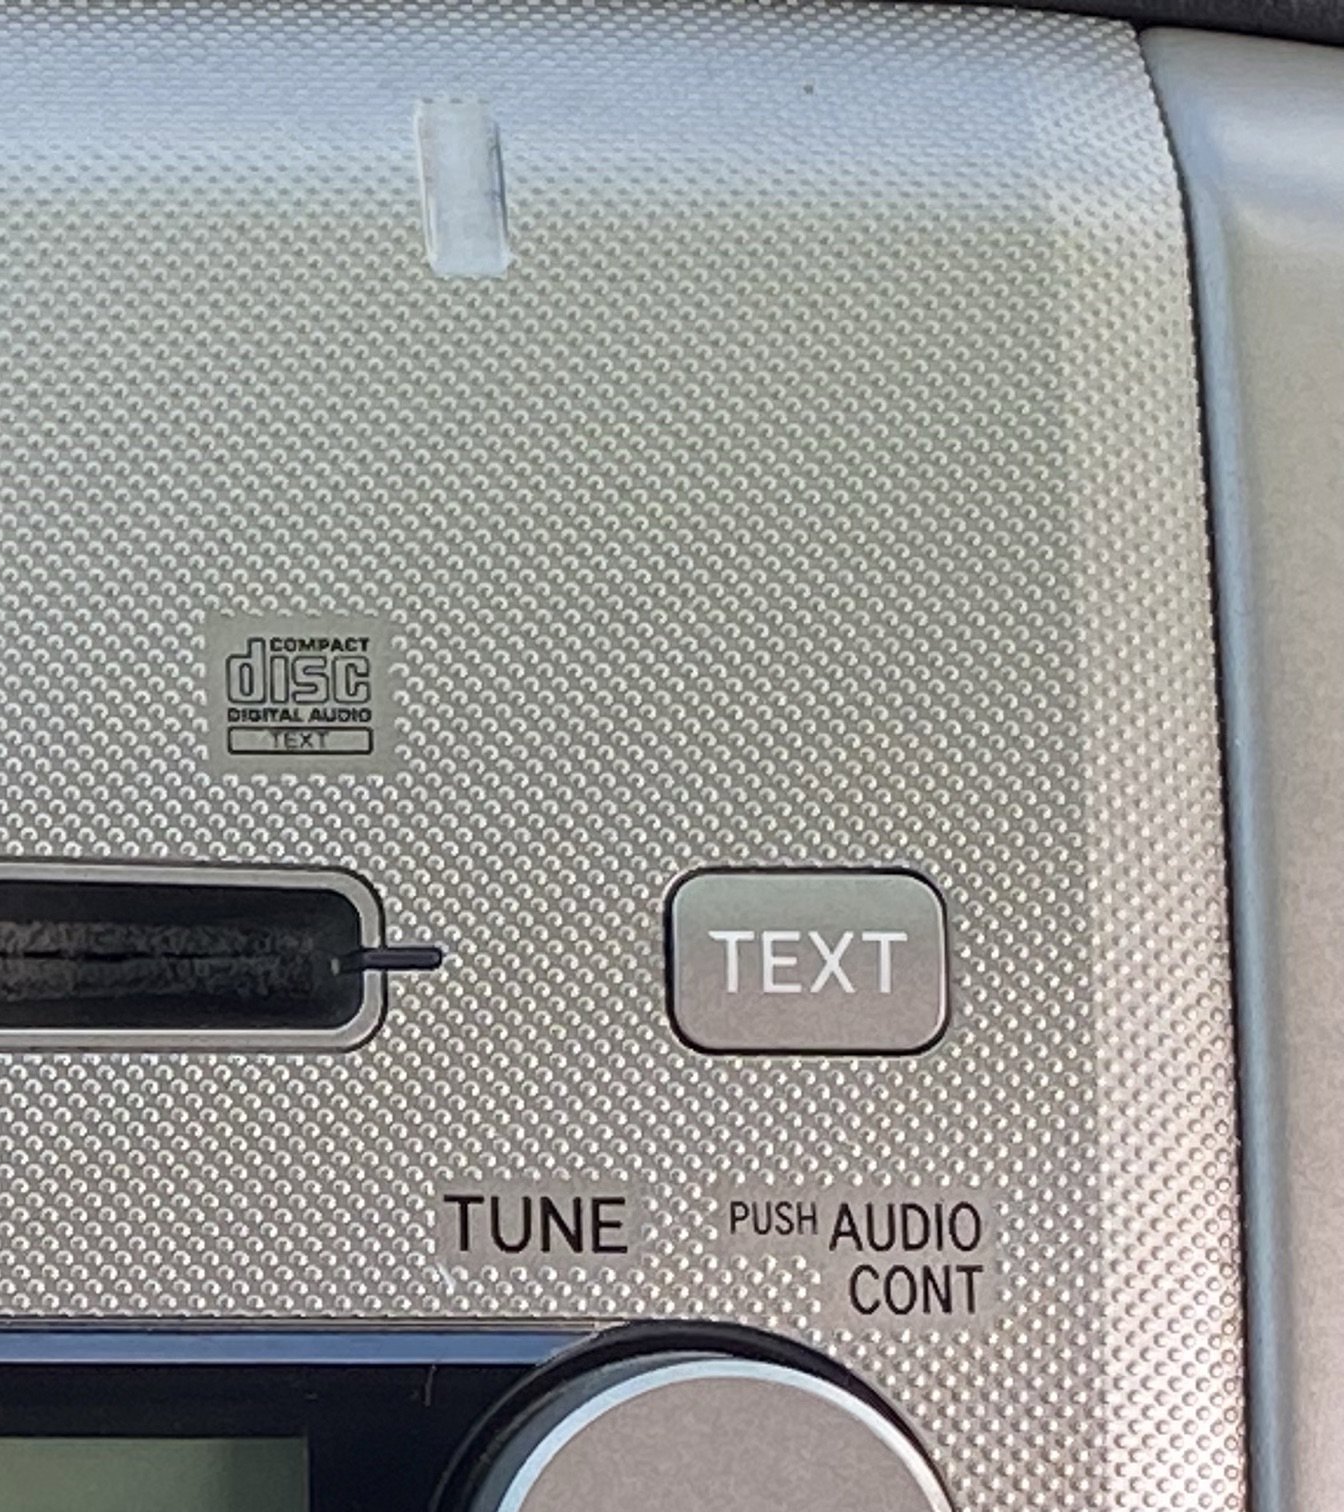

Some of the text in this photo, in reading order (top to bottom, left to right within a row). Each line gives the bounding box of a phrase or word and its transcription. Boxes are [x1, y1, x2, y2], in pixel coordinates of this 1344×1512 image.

[226, 637, 372, 704] disc
[269, 637, 370, 652] COMPACT
[227, 707, 373, 722] DIGITAL AUDIO
[268, 731, 331, 749] TEXT
[708, 930, 909, 994] TEXT
[444, 1195, 628, 1254] TUNE
[730, 1200, 982, 1253] PUSH AUDIO
[849, 1264, 984, 1316] CONT
